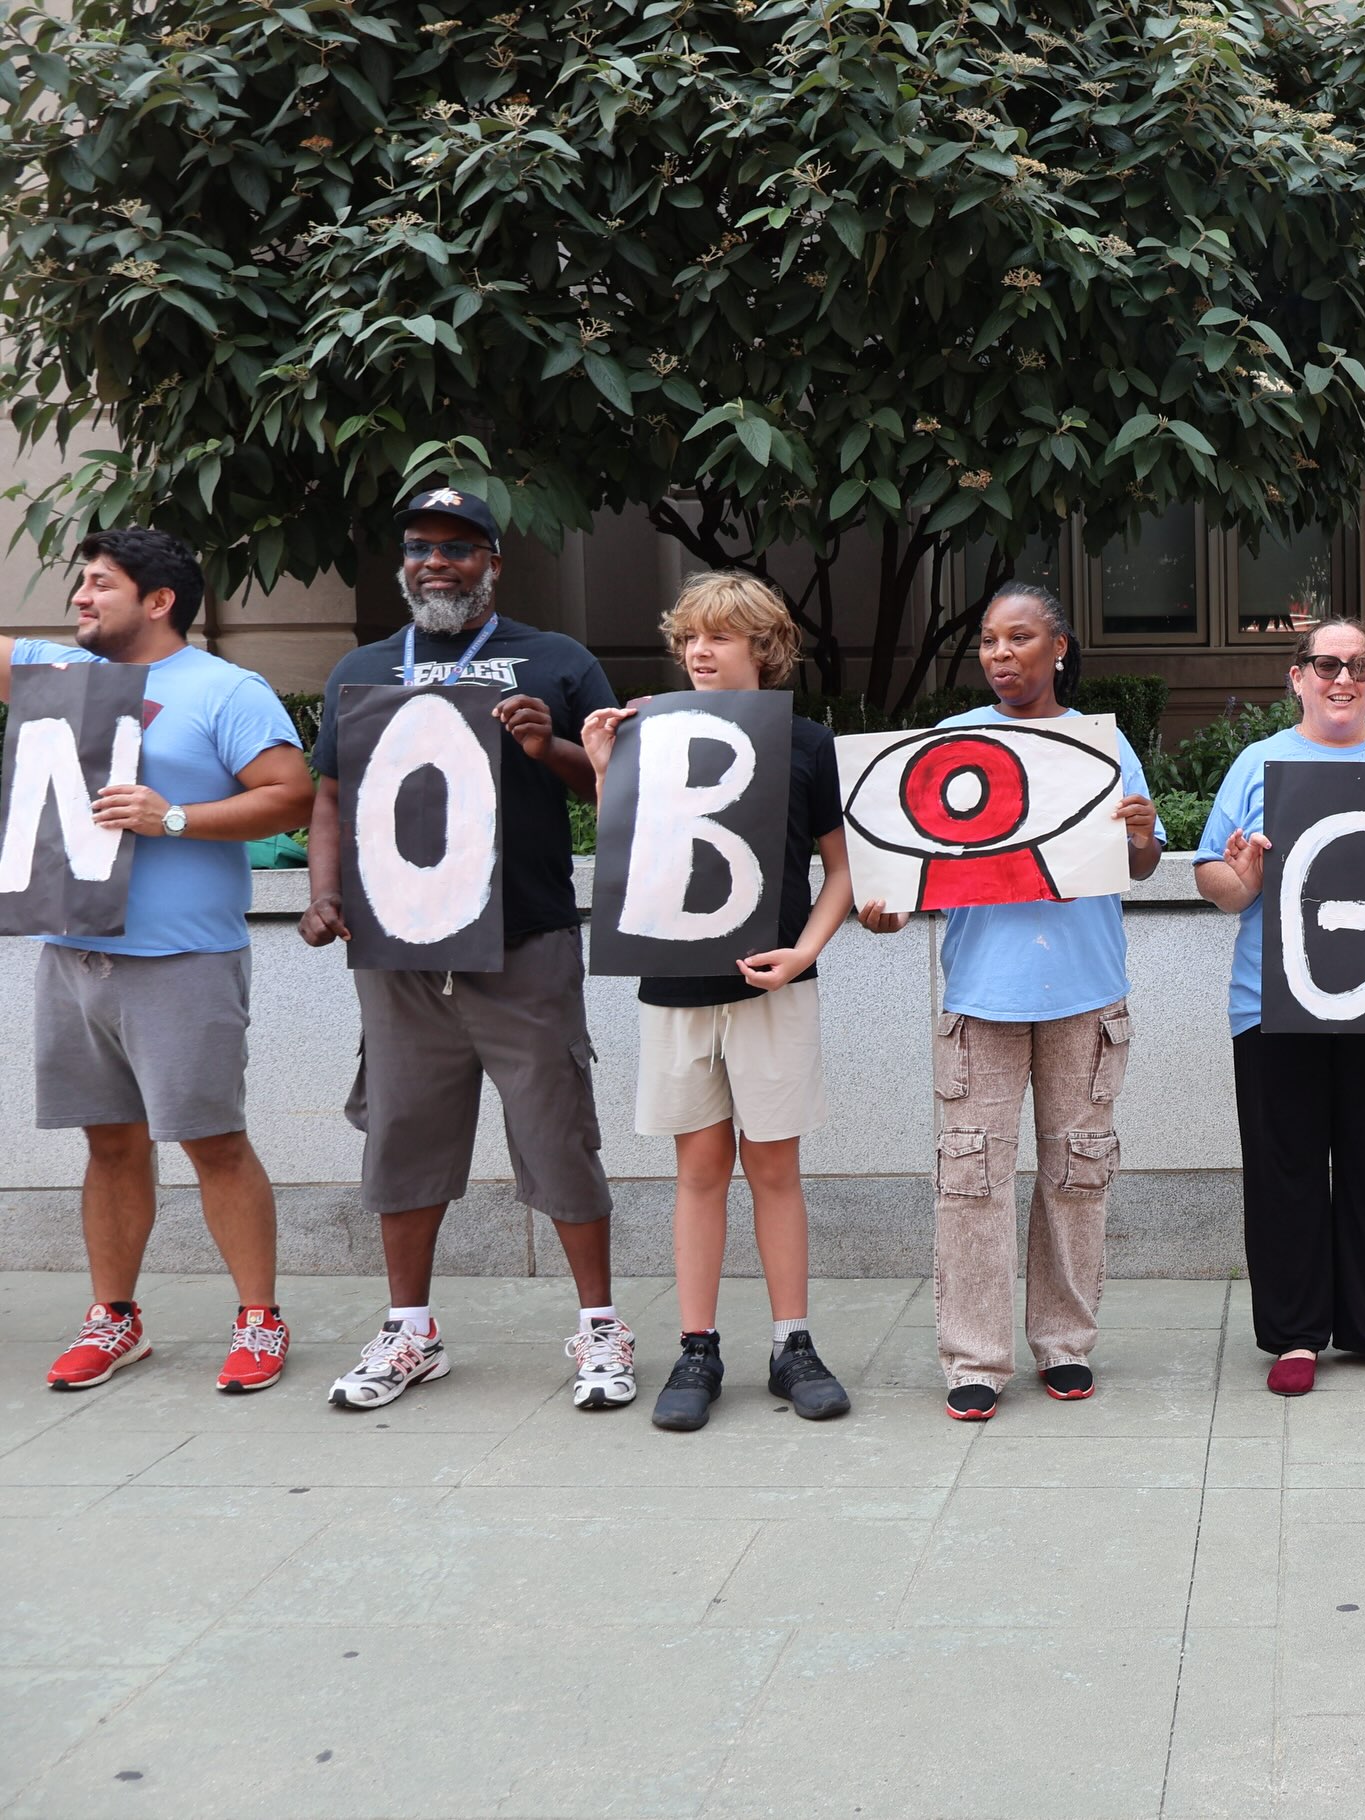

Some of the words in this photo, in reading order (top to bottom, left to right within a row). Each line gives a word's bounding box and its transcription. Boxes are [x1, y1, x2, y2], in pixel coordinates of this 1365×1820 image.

[0, 716, 142, 893] N
[355, 694, 496, 941] O
[617, 709, 764, 941] B
